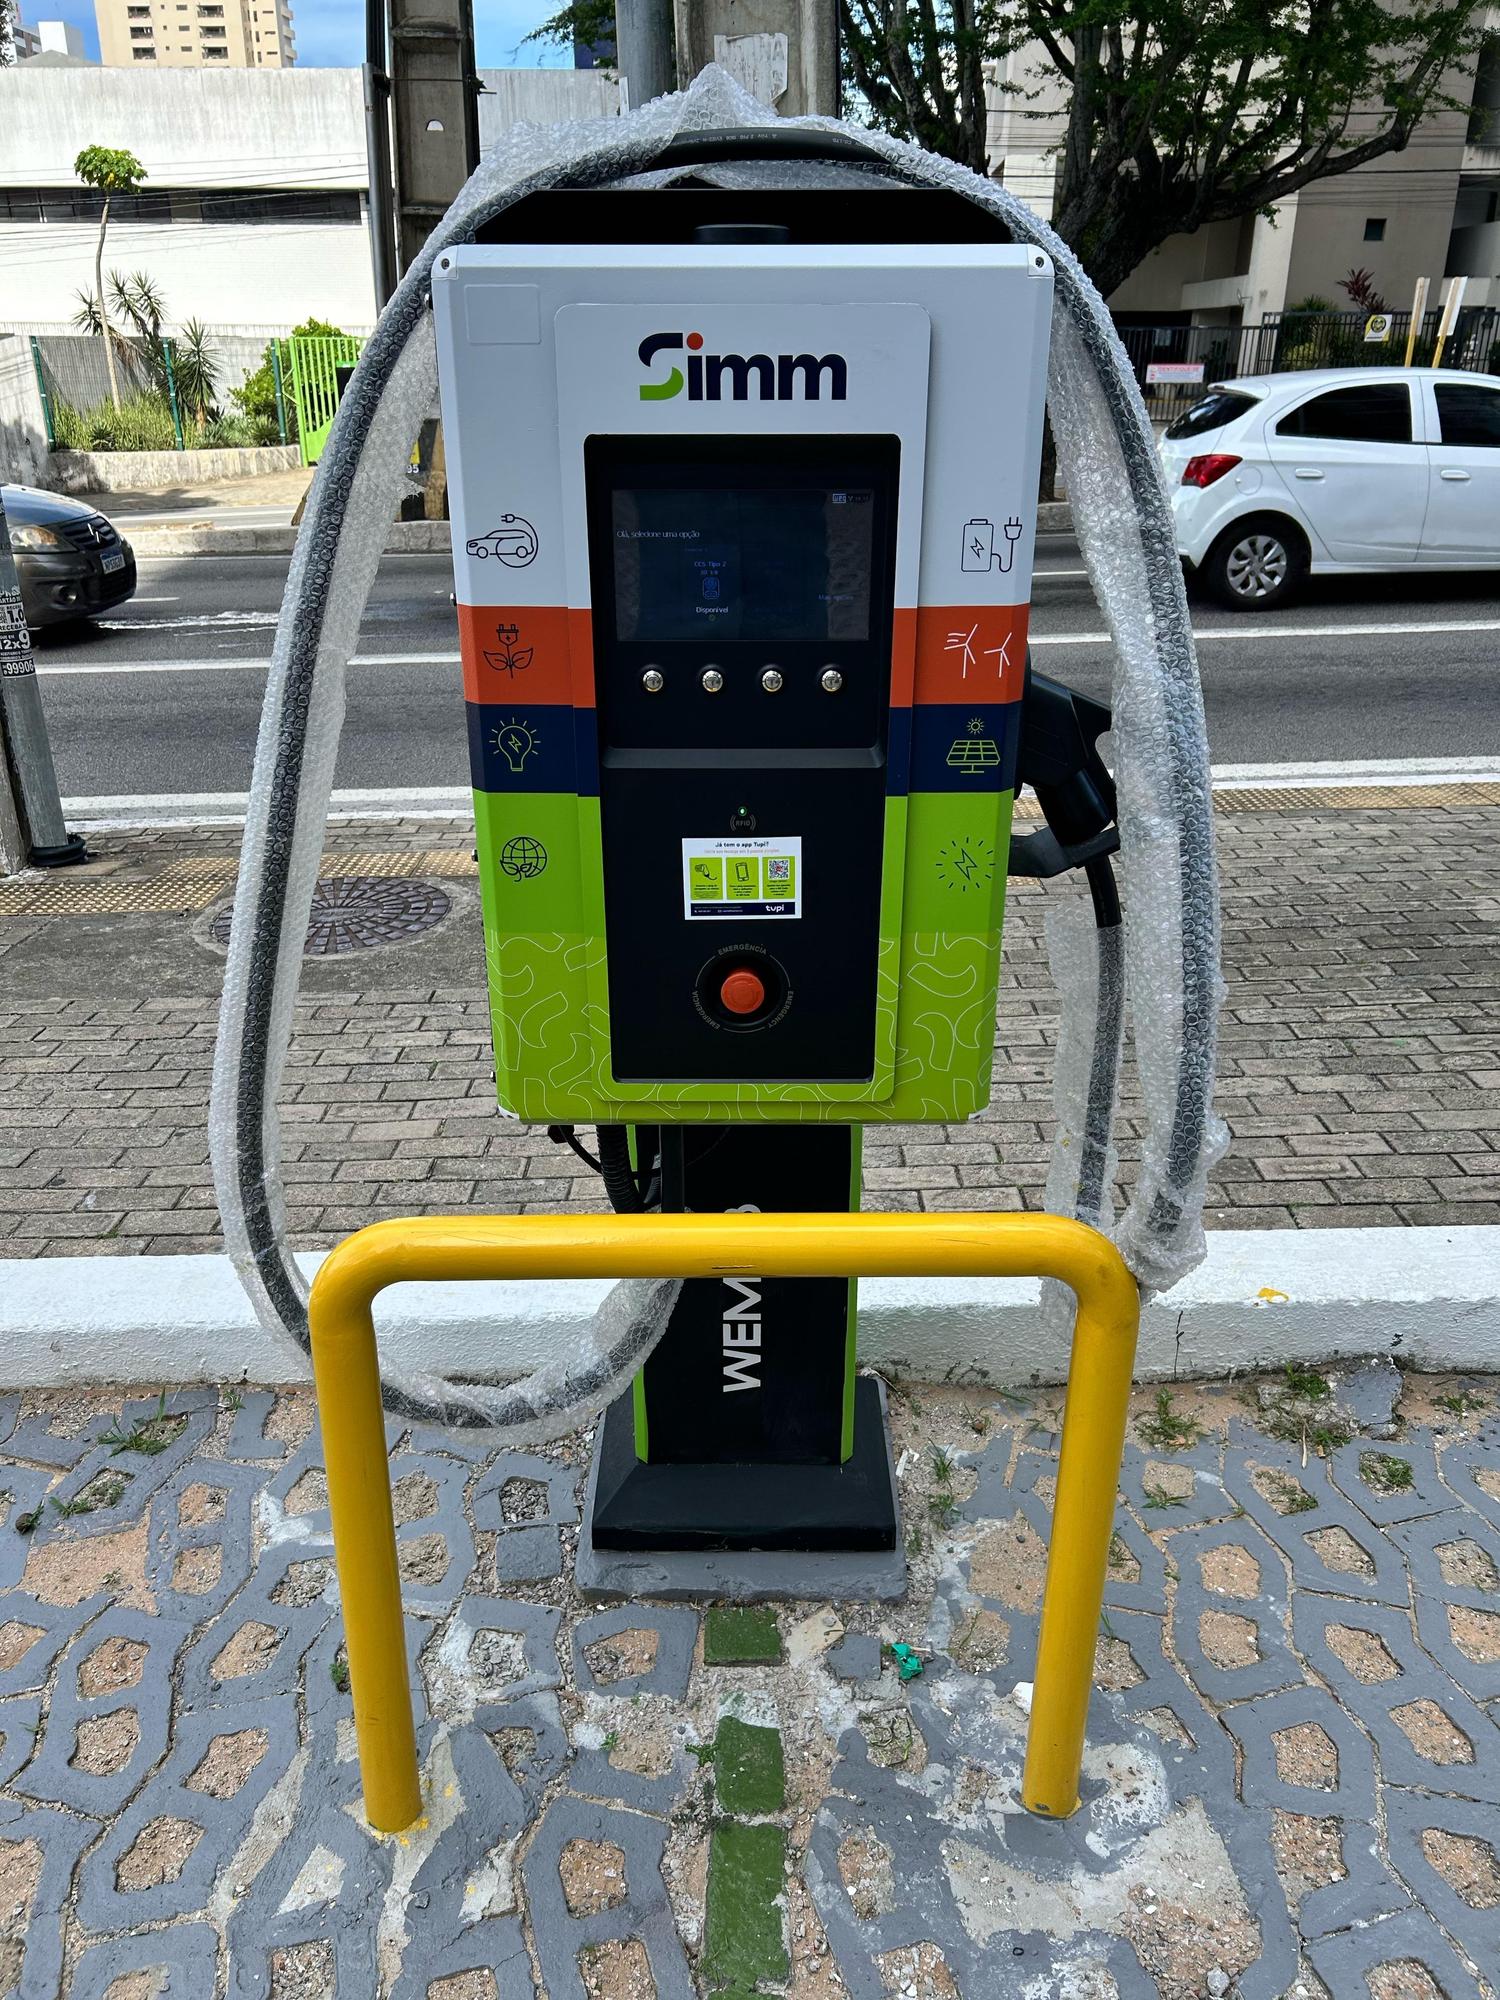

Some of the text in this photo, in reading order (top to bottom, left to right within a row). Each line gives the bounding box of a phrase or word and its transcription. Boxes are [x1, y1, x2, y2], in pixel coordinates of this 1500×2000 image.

[638, 332, 847, 401] Simm
[631, 530, 661, 538] selecione
[679, 530, 700, 540] opção
[695, 606, 729, 614] Disponível
[753, 841, 769, 849] Tupi?
[765, 904, 785, 913] tupi
